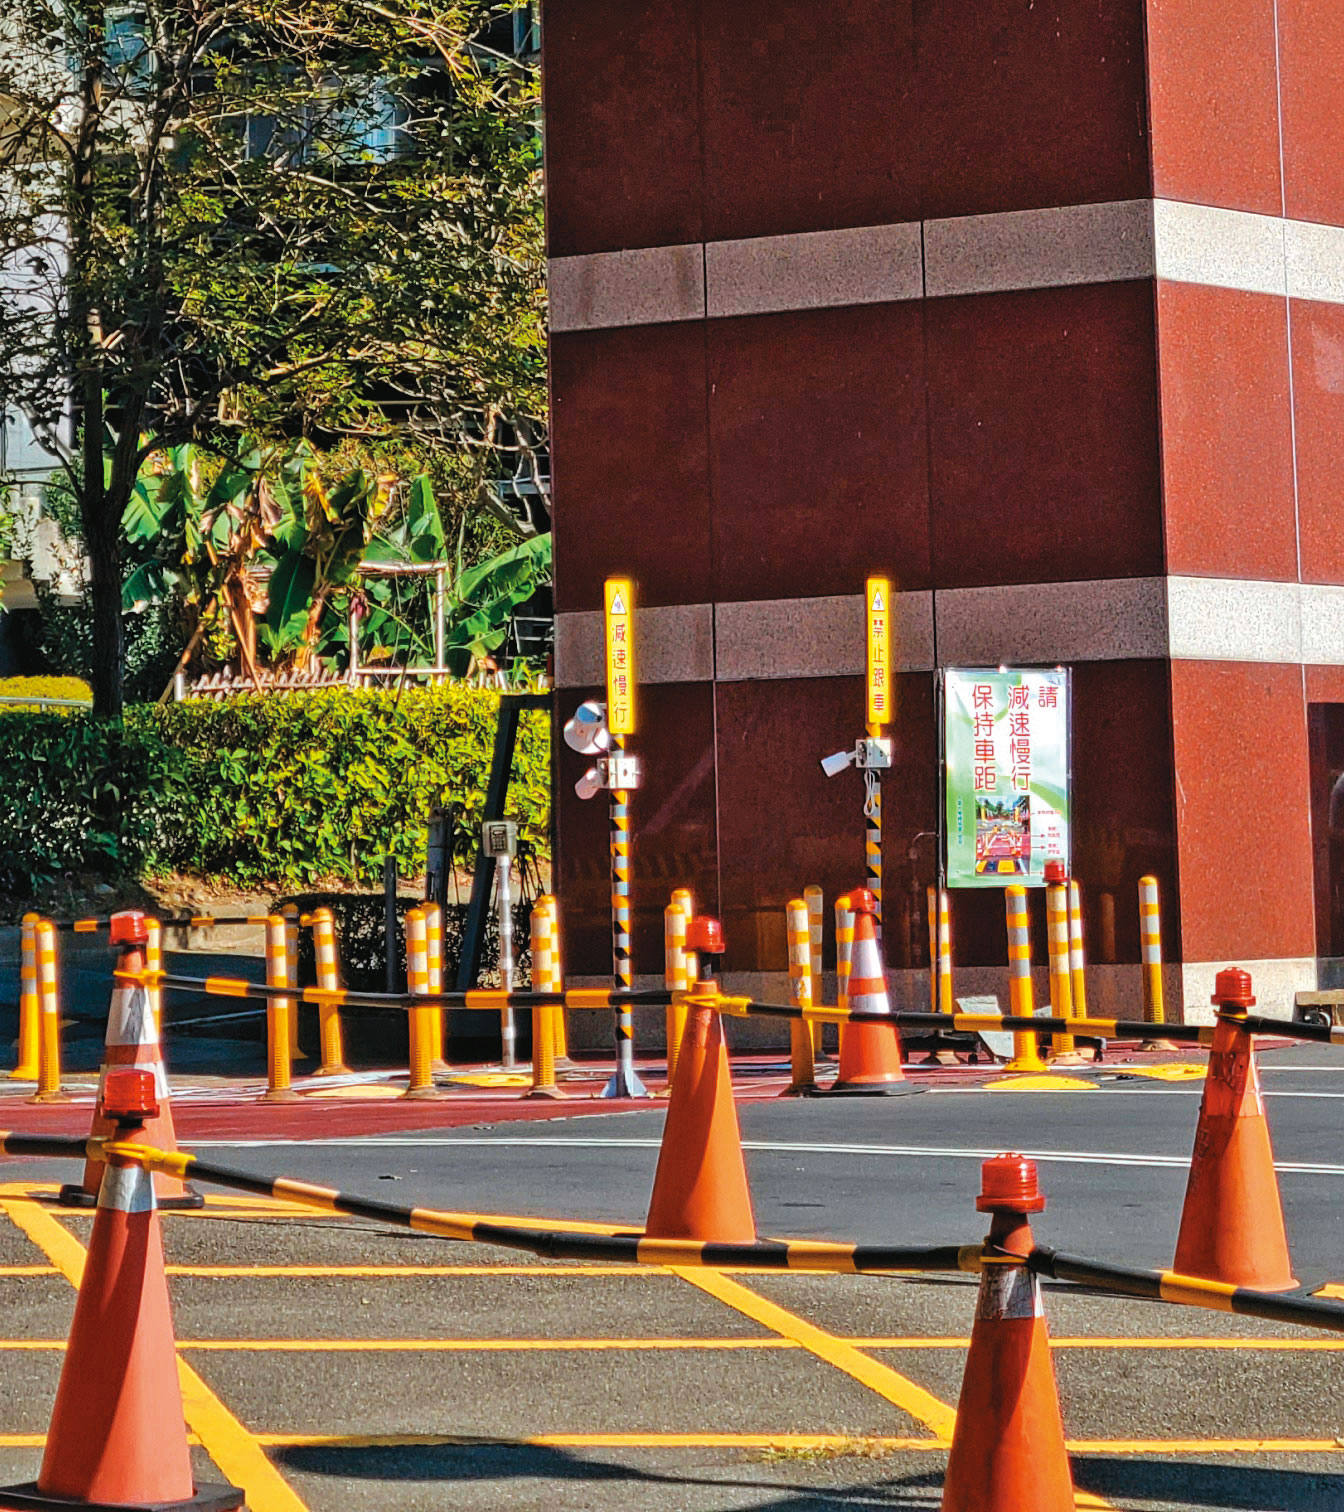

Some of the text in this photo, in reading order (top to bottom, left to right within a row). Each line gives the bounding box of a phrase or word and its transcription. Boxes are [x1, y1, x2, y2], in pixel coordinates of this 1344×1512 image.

[612, 622, 627, 724] 減速慢行
[873, 619, 884, 711] 禁止跟車
[1038, 685, 1058, 708] 請
[972, 684, 996, 791] 保持車距
[1008, 684, 1031, 791] 減速慢行
